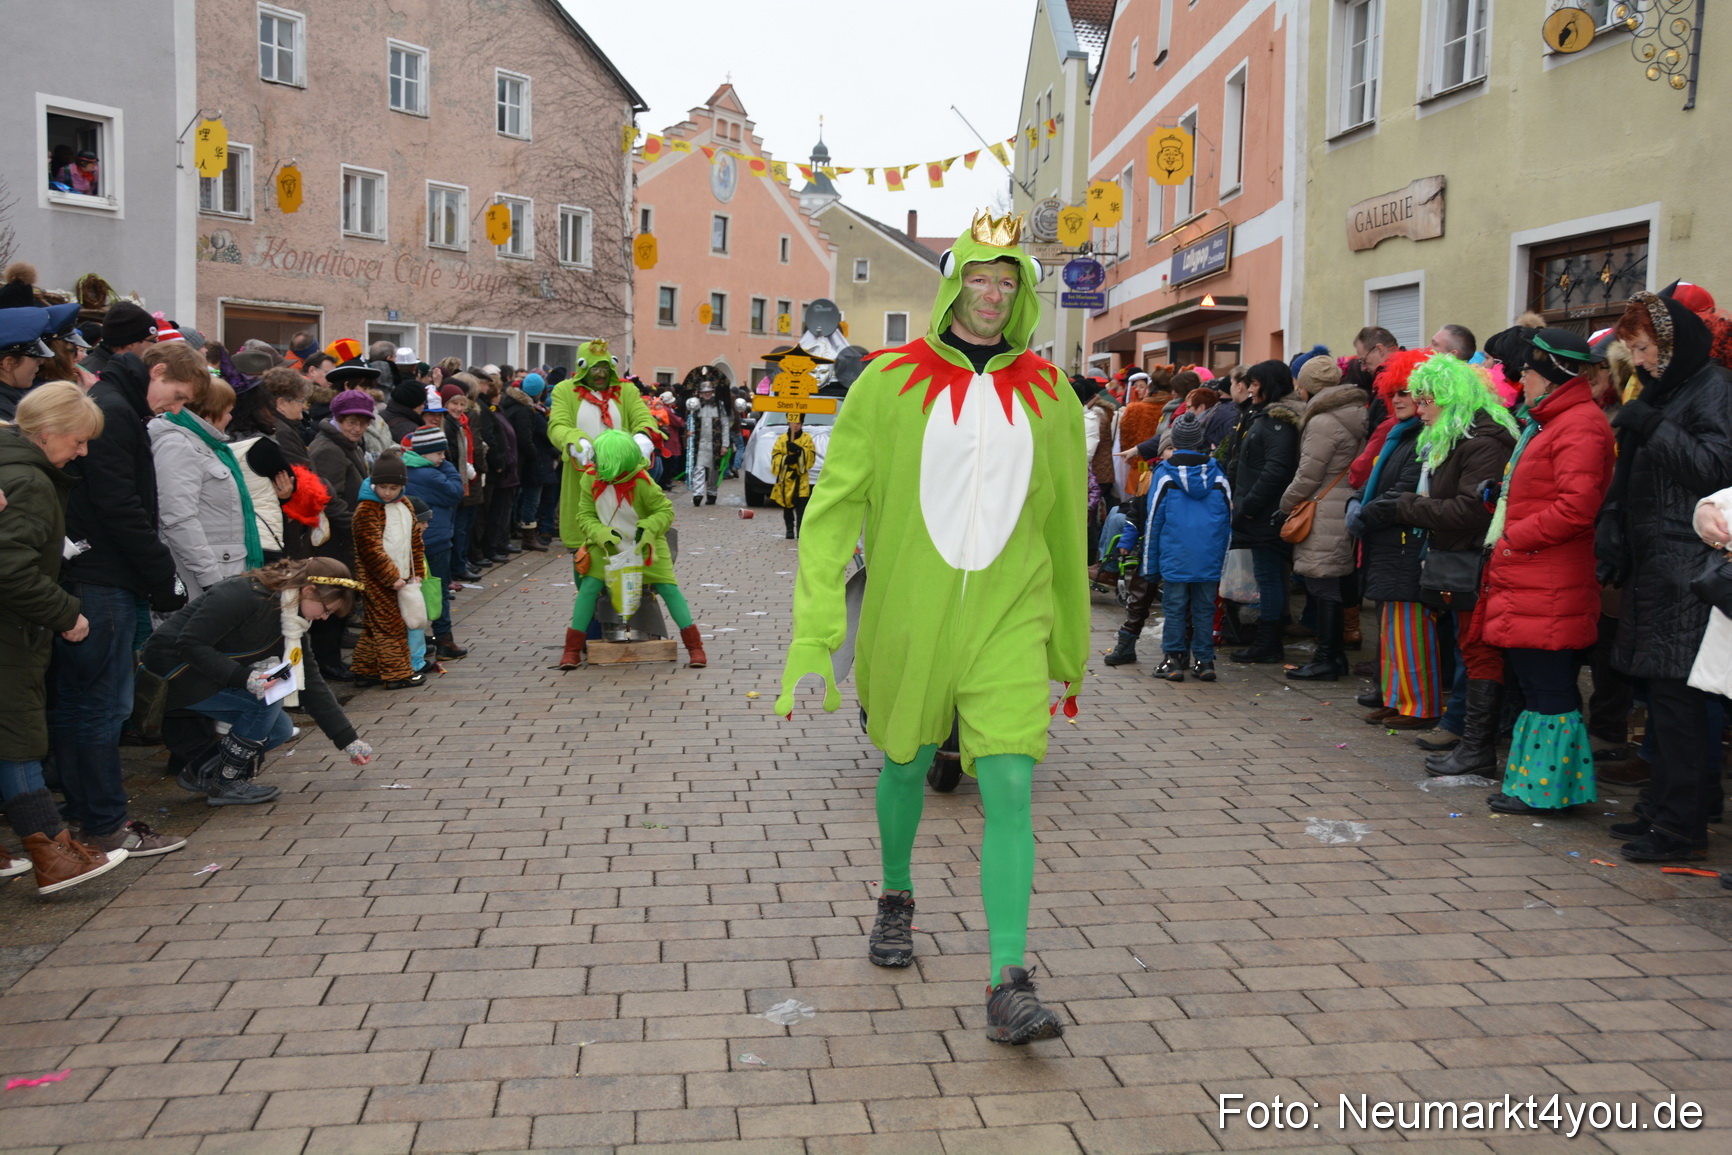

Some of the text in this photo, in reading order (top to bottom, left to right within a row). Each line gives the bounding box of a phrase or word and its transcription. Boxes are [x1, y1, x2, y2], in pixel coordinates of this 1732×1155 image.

[1354, 196, 1413, 233] GALERIE
[261, 235, 386, 281] Konditorei
[777, 401, 808, 410] Shen Yun
[788, 413, 799, 422] 37
